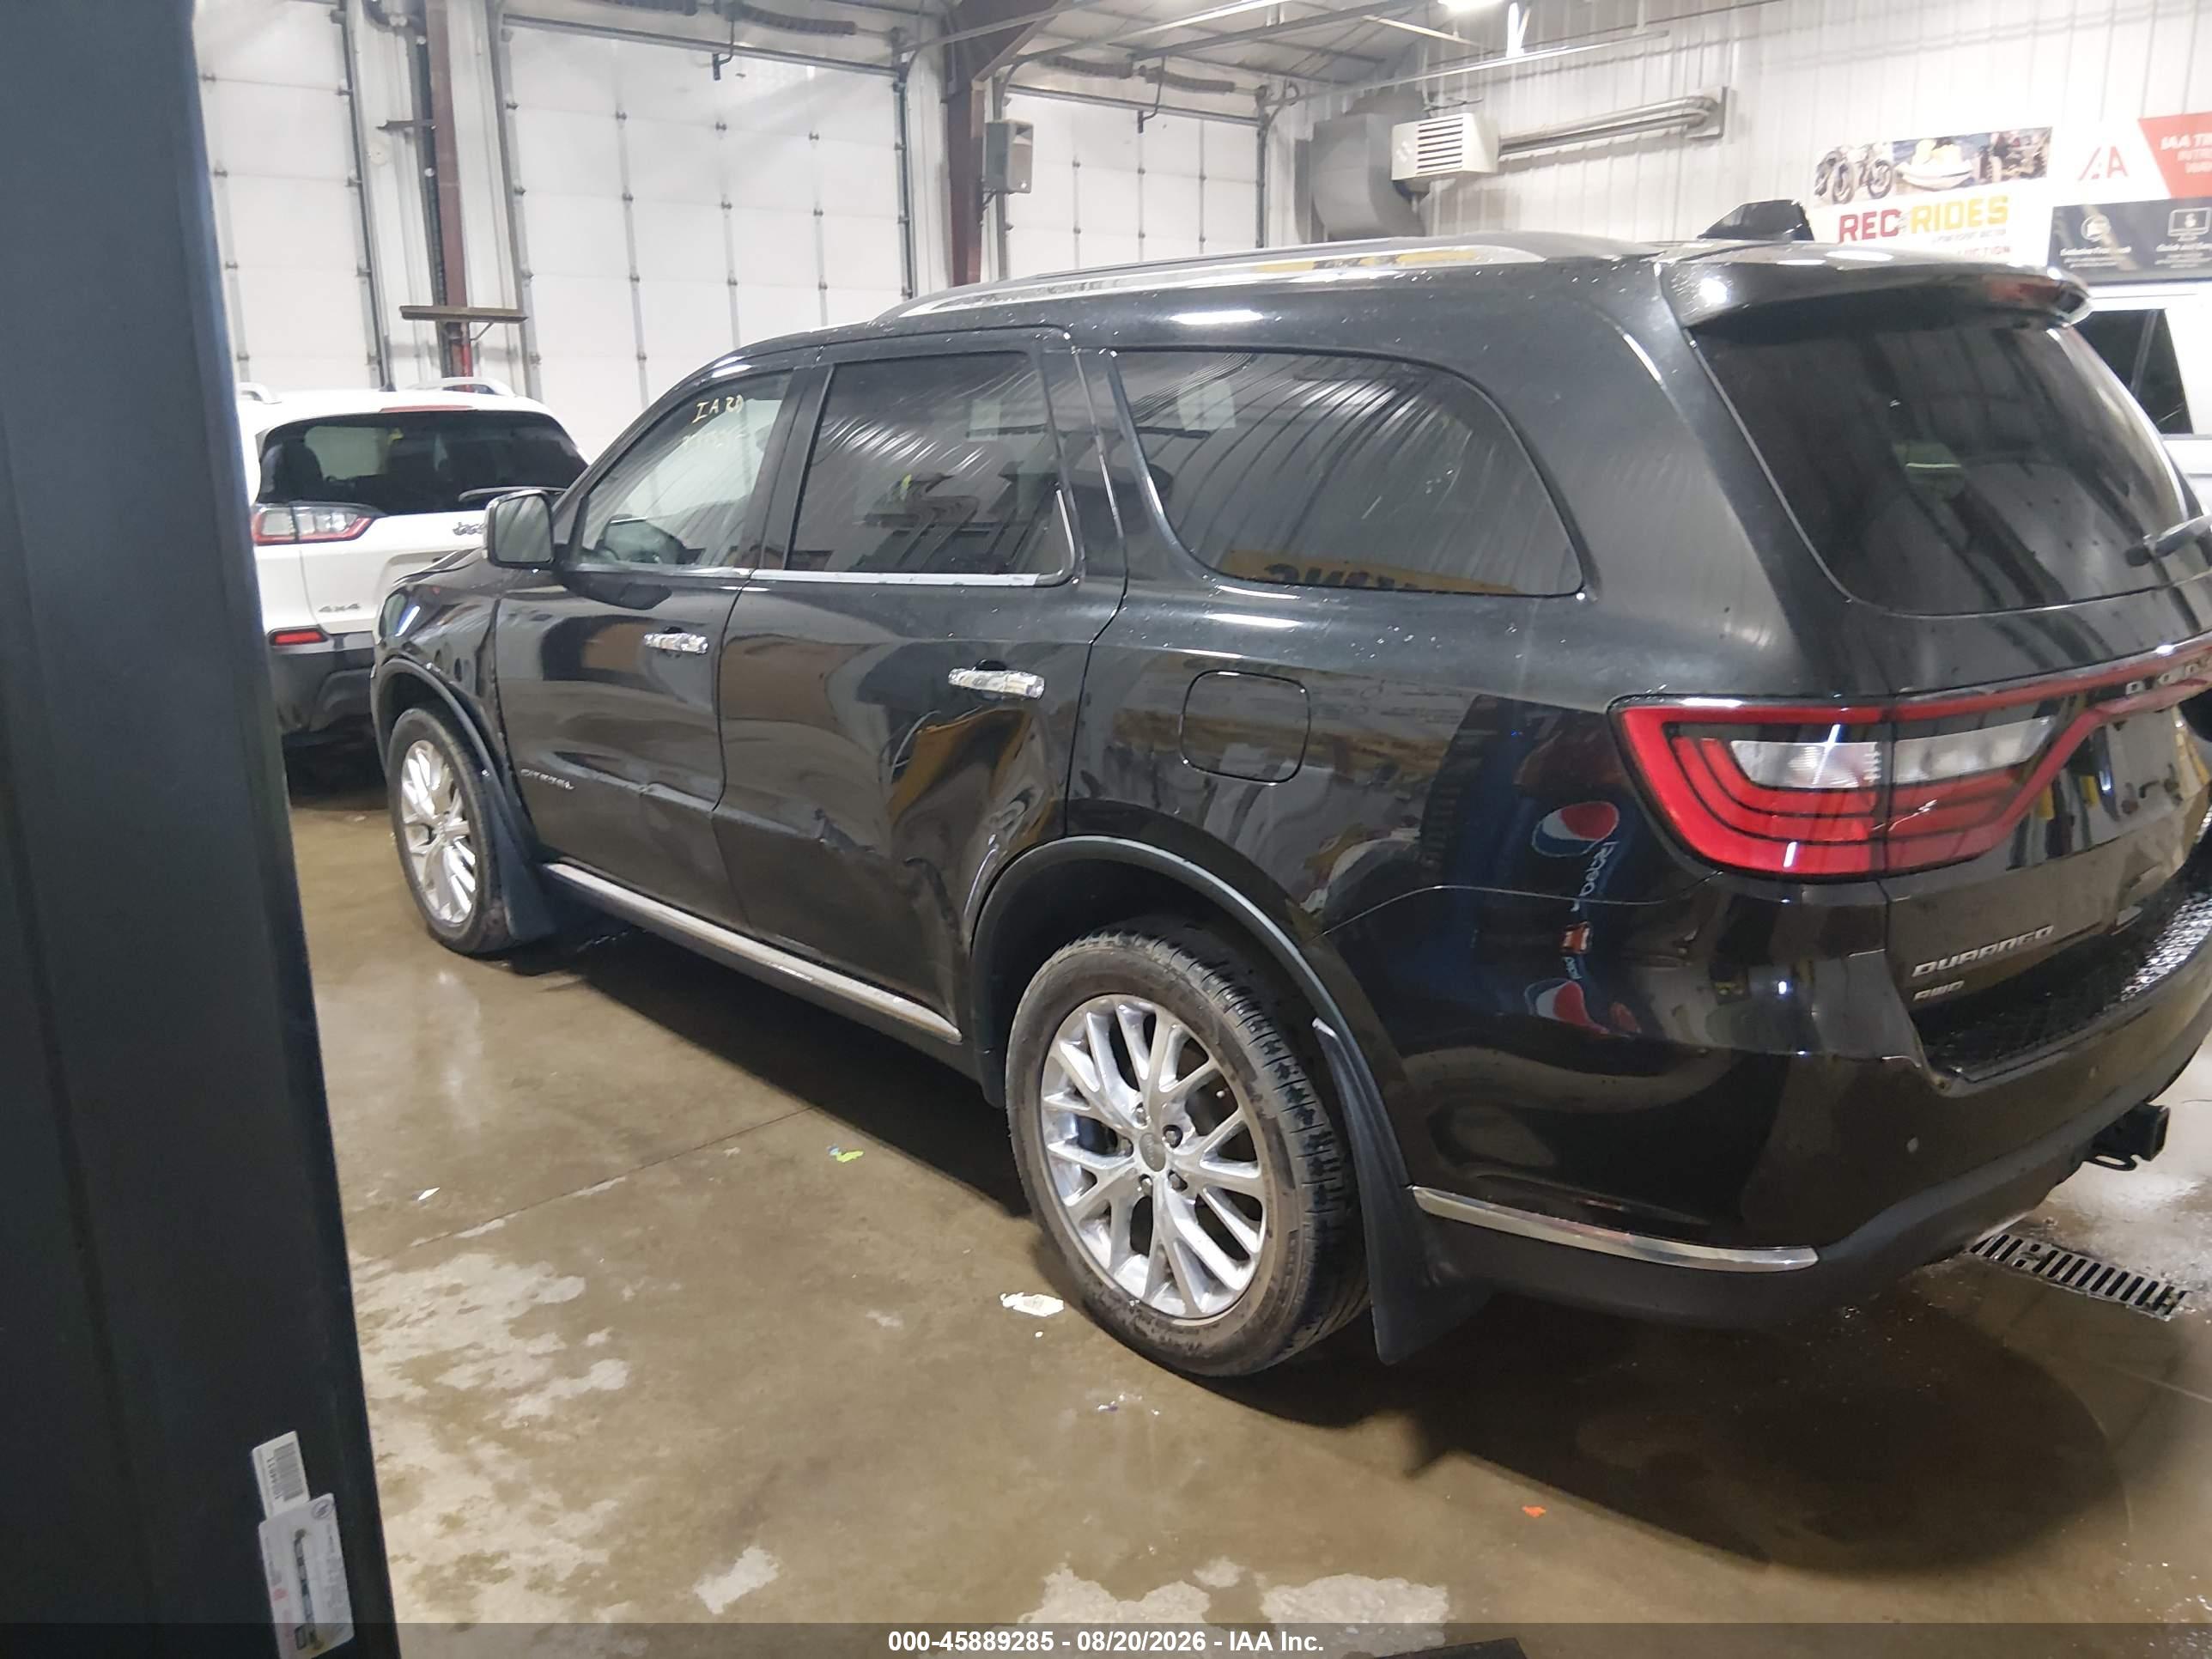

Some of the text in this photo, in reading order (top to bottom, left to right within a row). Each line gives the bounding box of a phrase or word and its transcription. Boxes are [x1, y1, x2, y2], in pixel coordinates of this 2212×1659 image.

[1838, 209, 1901, 244] REC
[1910, 195, 2009, 234] RIDES
[1911, 925, 2055, 978] DURANGO
[1912, 980, 1966, 1001] AWD
